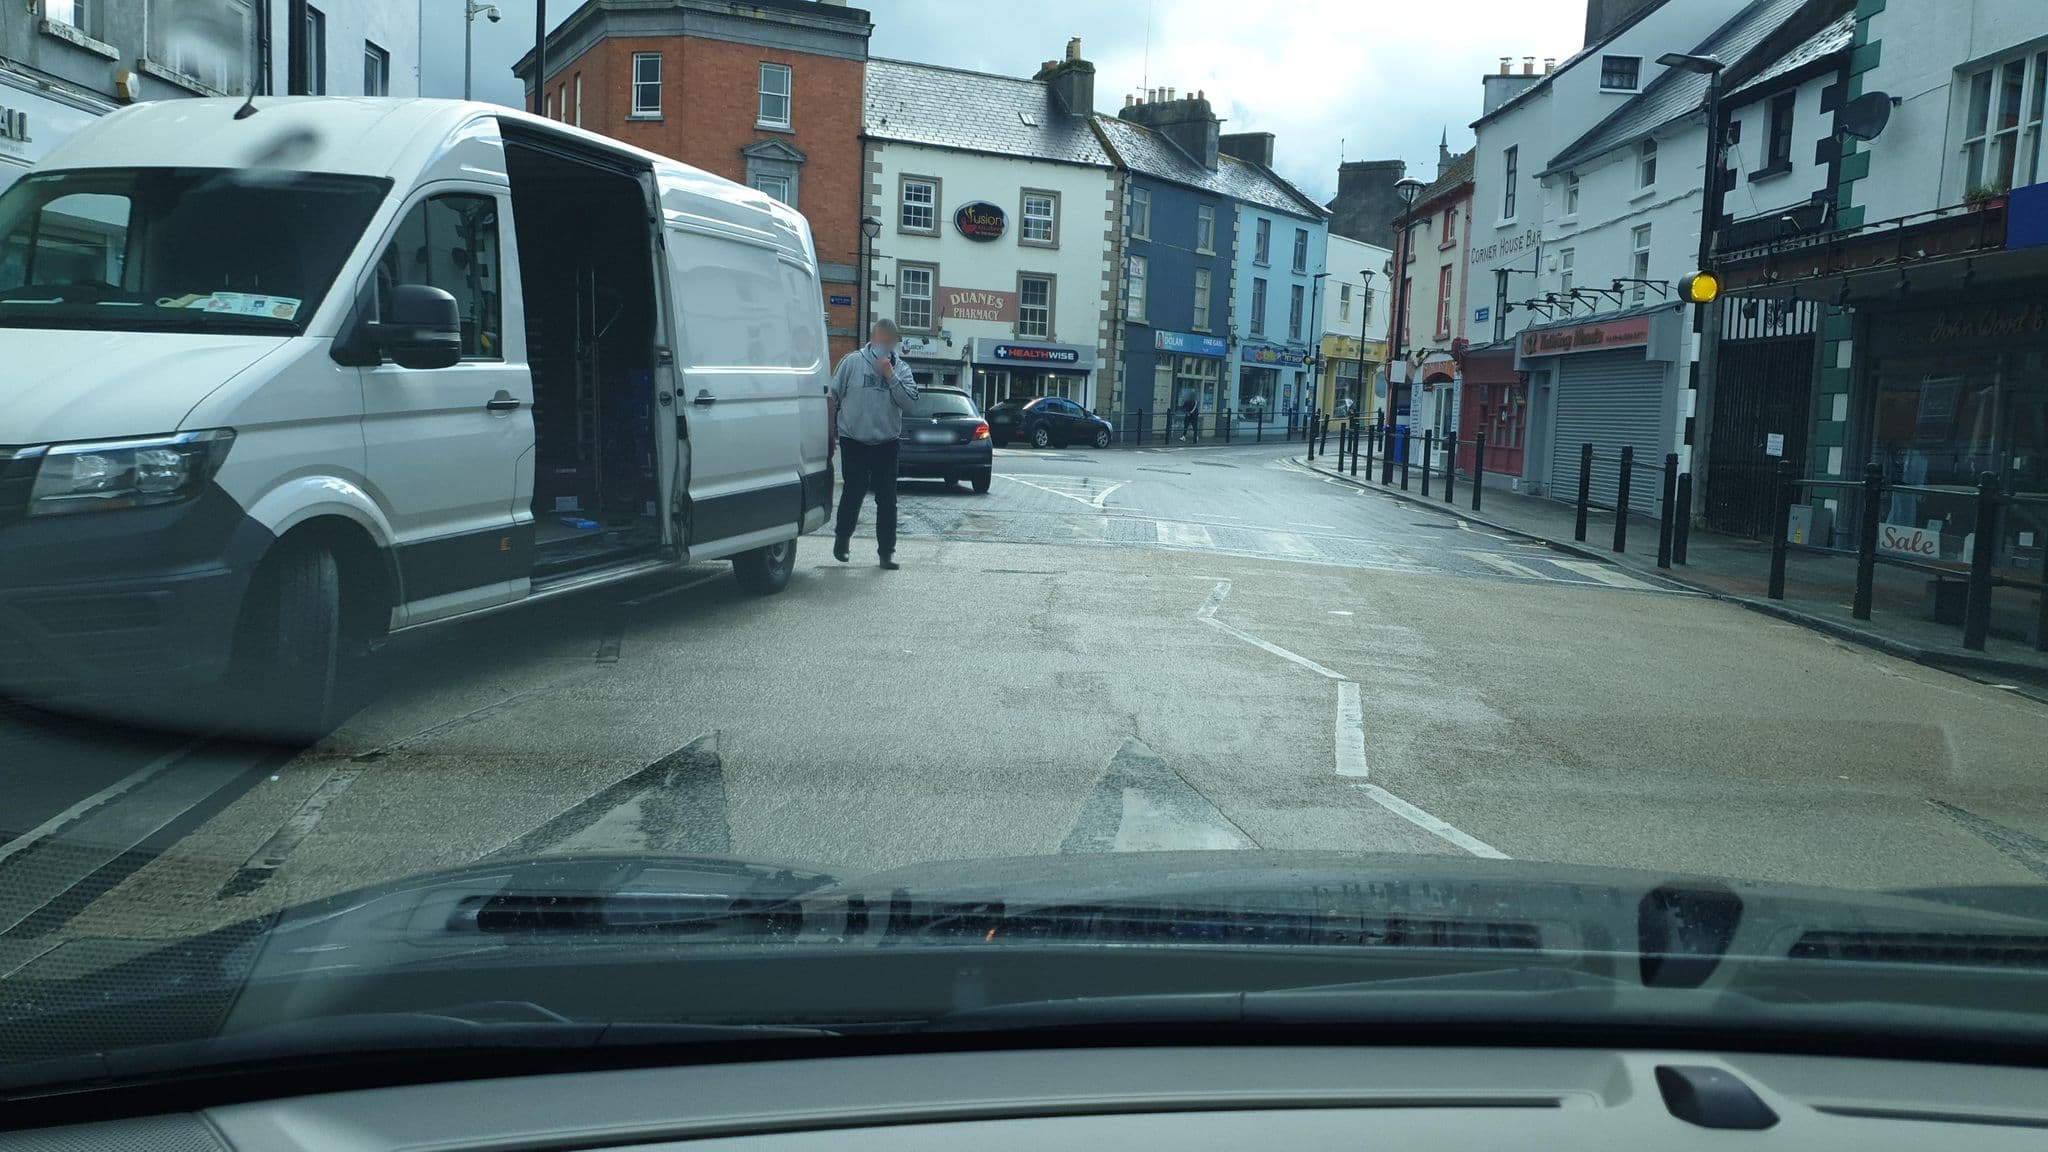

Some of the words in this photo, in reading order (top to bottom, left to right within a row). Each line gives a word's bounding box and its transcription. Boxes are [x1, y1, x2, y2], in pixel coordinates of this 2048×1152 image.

[1471, 243, 1497, 264] CORNER
[1500, 235, 1524, 257] HOUSE
[1526, 229, 1541, 249] BAR
[950, 292, 1004, 309] DUANES
[953, 307, 1000, 320] PHARMACY
[1164, 336, 1184, 347] DOLAN
[1008, 348, 1075, 360] HEALTHWISE
[1881, 526, 1935, 555] Sale
